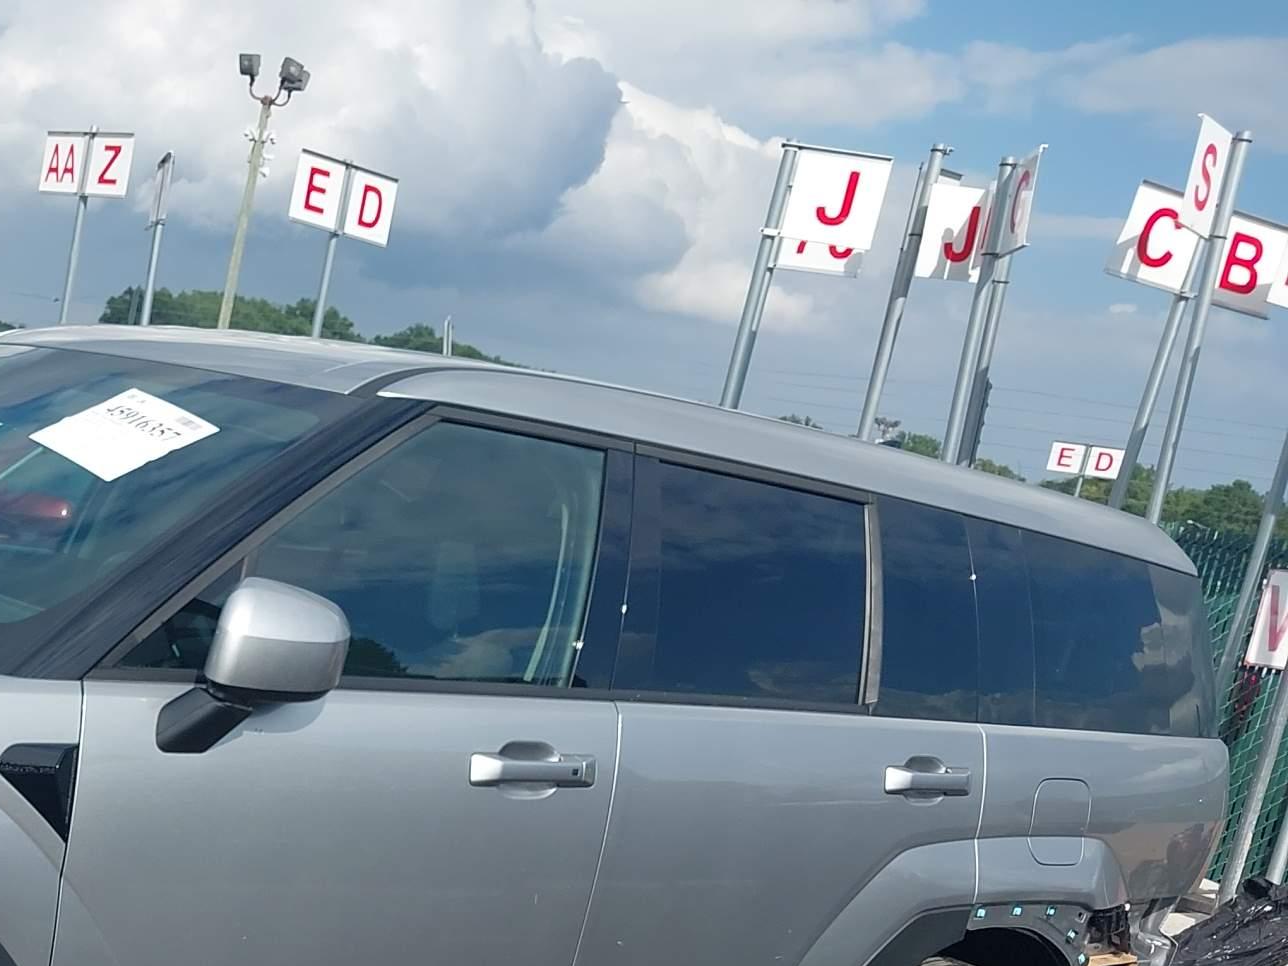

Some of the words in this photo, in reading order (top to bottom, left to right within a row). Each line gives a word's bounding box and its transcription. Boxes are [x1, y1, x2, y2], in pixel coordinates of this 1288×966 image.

[45, 143, 75, 183] AA
[97, 145, 122, 185] Z
[1194, 143, 1218, 212] S
[304, 166, 331, 215] E
[357, 184, 383, 229] D
[815, 170, 861, 226] J
[943, 205, 981, 263] J
[1136, 207, 1185, 268] C
[1219, 231, 1264, 295] B
[1057, 447, 1075, 468] E
[1095, 452, 1113, 471] D
